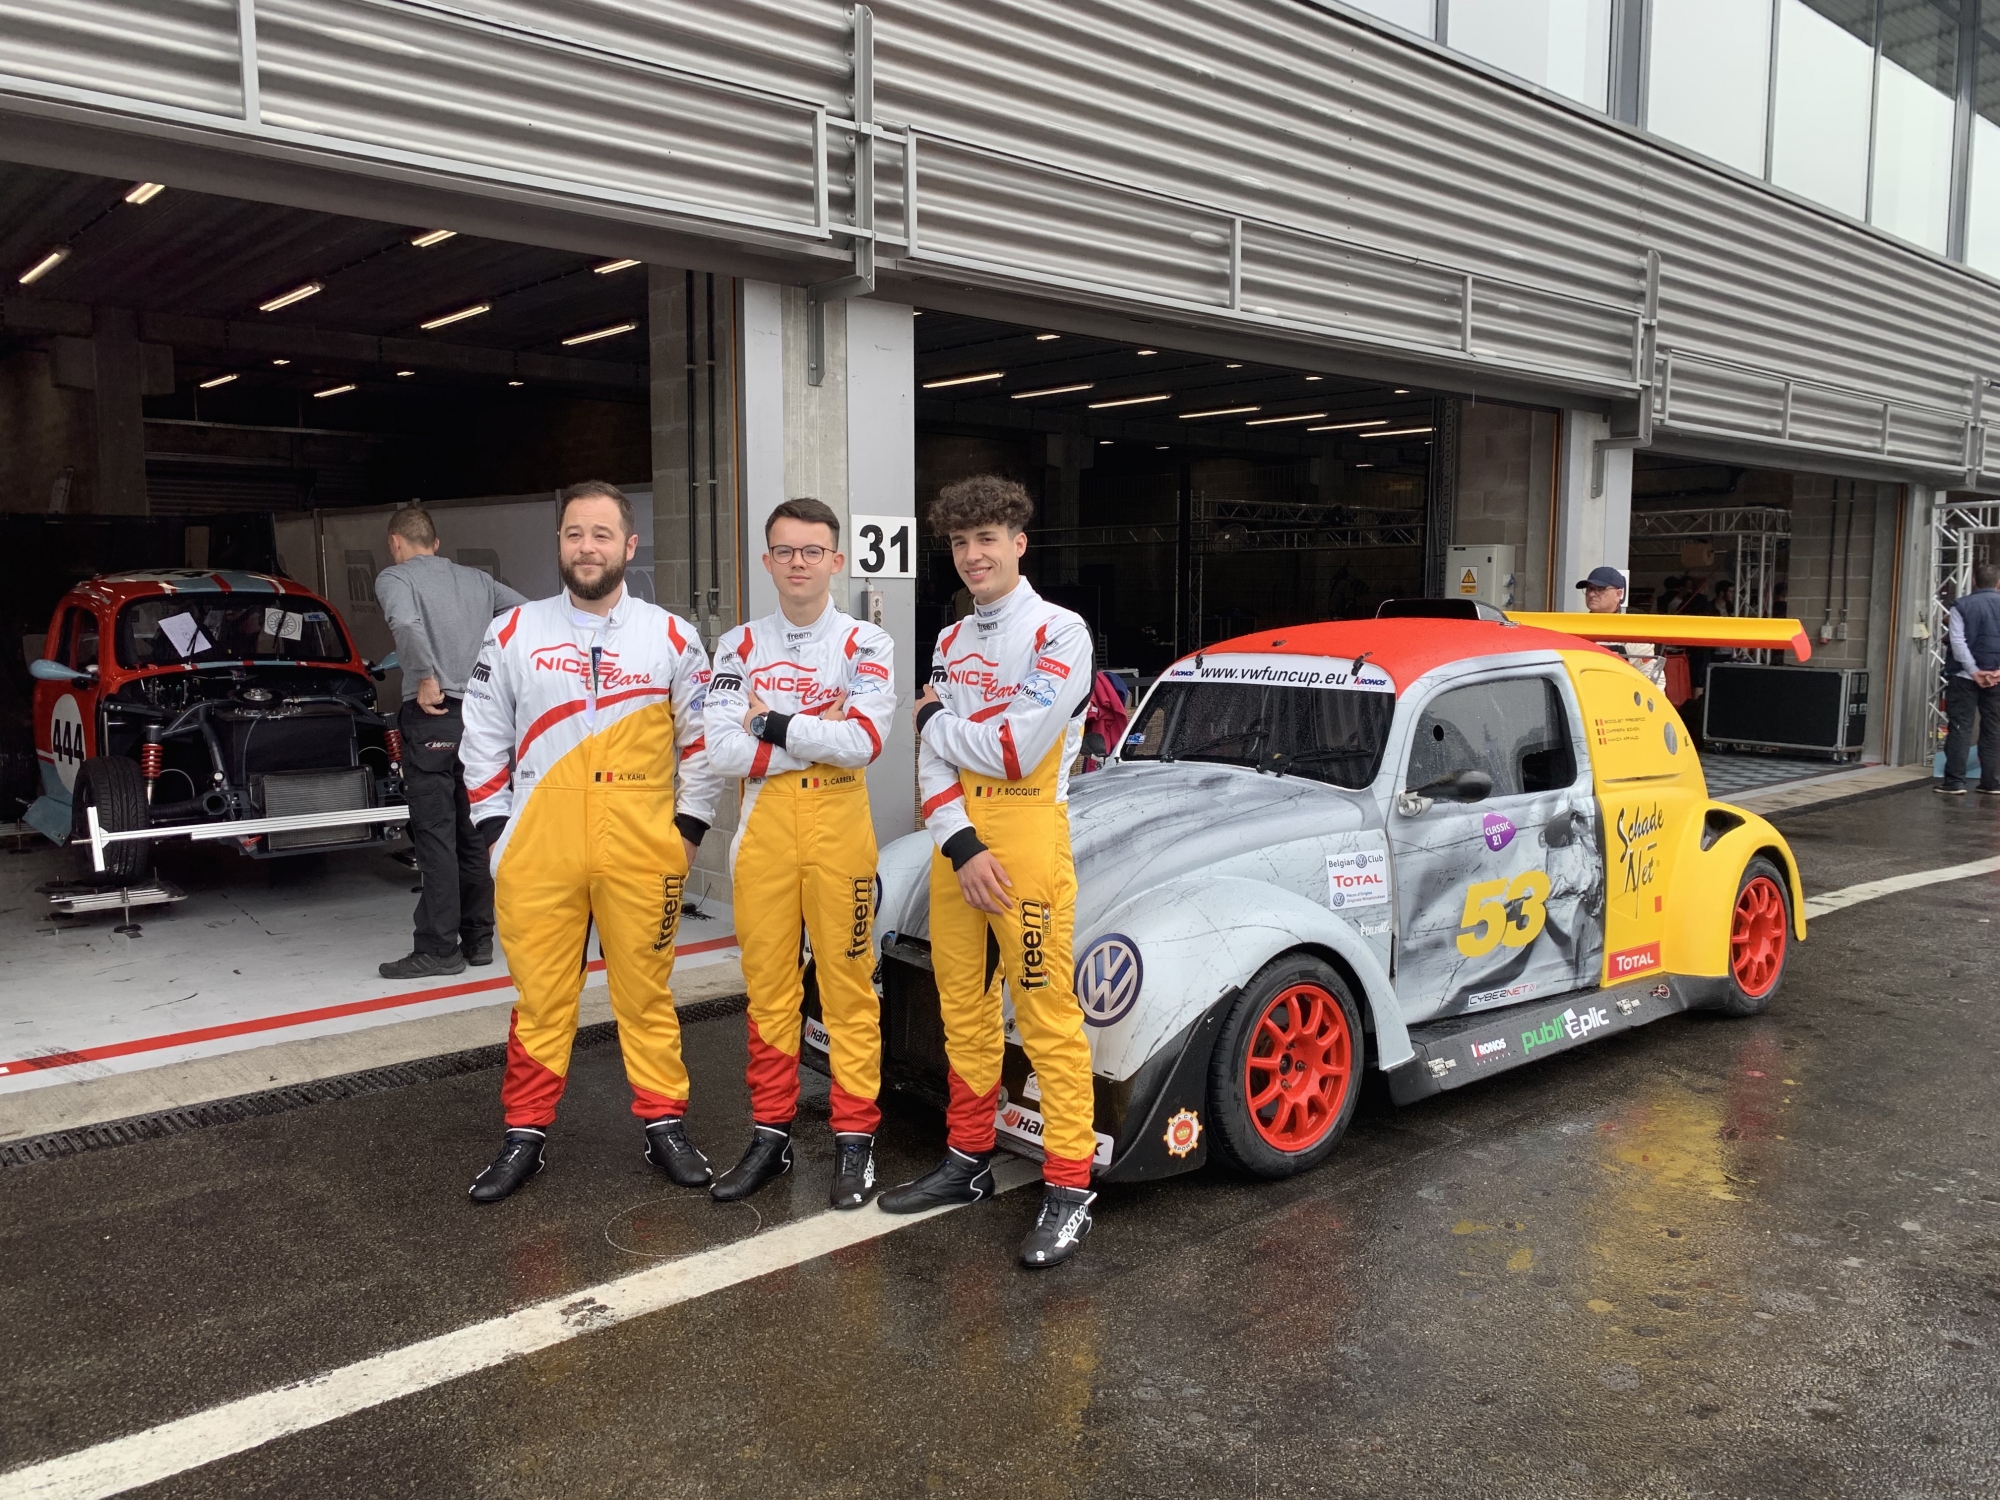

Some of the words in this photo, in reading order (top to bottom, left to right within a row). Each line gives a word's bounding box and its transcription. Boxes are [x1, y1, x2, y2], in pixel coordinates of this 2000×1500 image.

[859, 524, 909, 573] 31
[786, 631, 813, 642] freem
[860, 664, 888, 678] TOTAL
[1039, 659, 1068, 676] TOTAL
[1201, 665, 1348, 687] www.vwfuncup.eu
[1353, 675, 1388, 686] KRONOS
[602, 667, 652, 690] Cars
[753, 677, 813, 691] NICE
[950, 670, 994, 687] NICE
[53, 718, 85, 766] 444
[618, 773, 626, 782] A.
[997, 787, 1003, 796] F.
[1004, 787, 1041, 797] BOCQUET
[1485, 821, 1511, 837] CLASSIC
[1617, 801, 1665, 864] Schade
[1492, 833, 1503, 846] 21
[1328, 858, 1355, 869] Belgian
[1367, 854, 1384, 864] Club
[1333, 873, 1383, 888] TOTAL
[653, 875, 680, 952] freem
[846, 879, 869, 959] freem
[1456, 870, 1551, 958] 53
[1020, 900, 1044, 991] freem
[1616, 951, 1655, 972] TOTAL
[1470, 1037, 1507, 1058] KRONOS
[1173, 1140, 1194, 1152] SPORT
